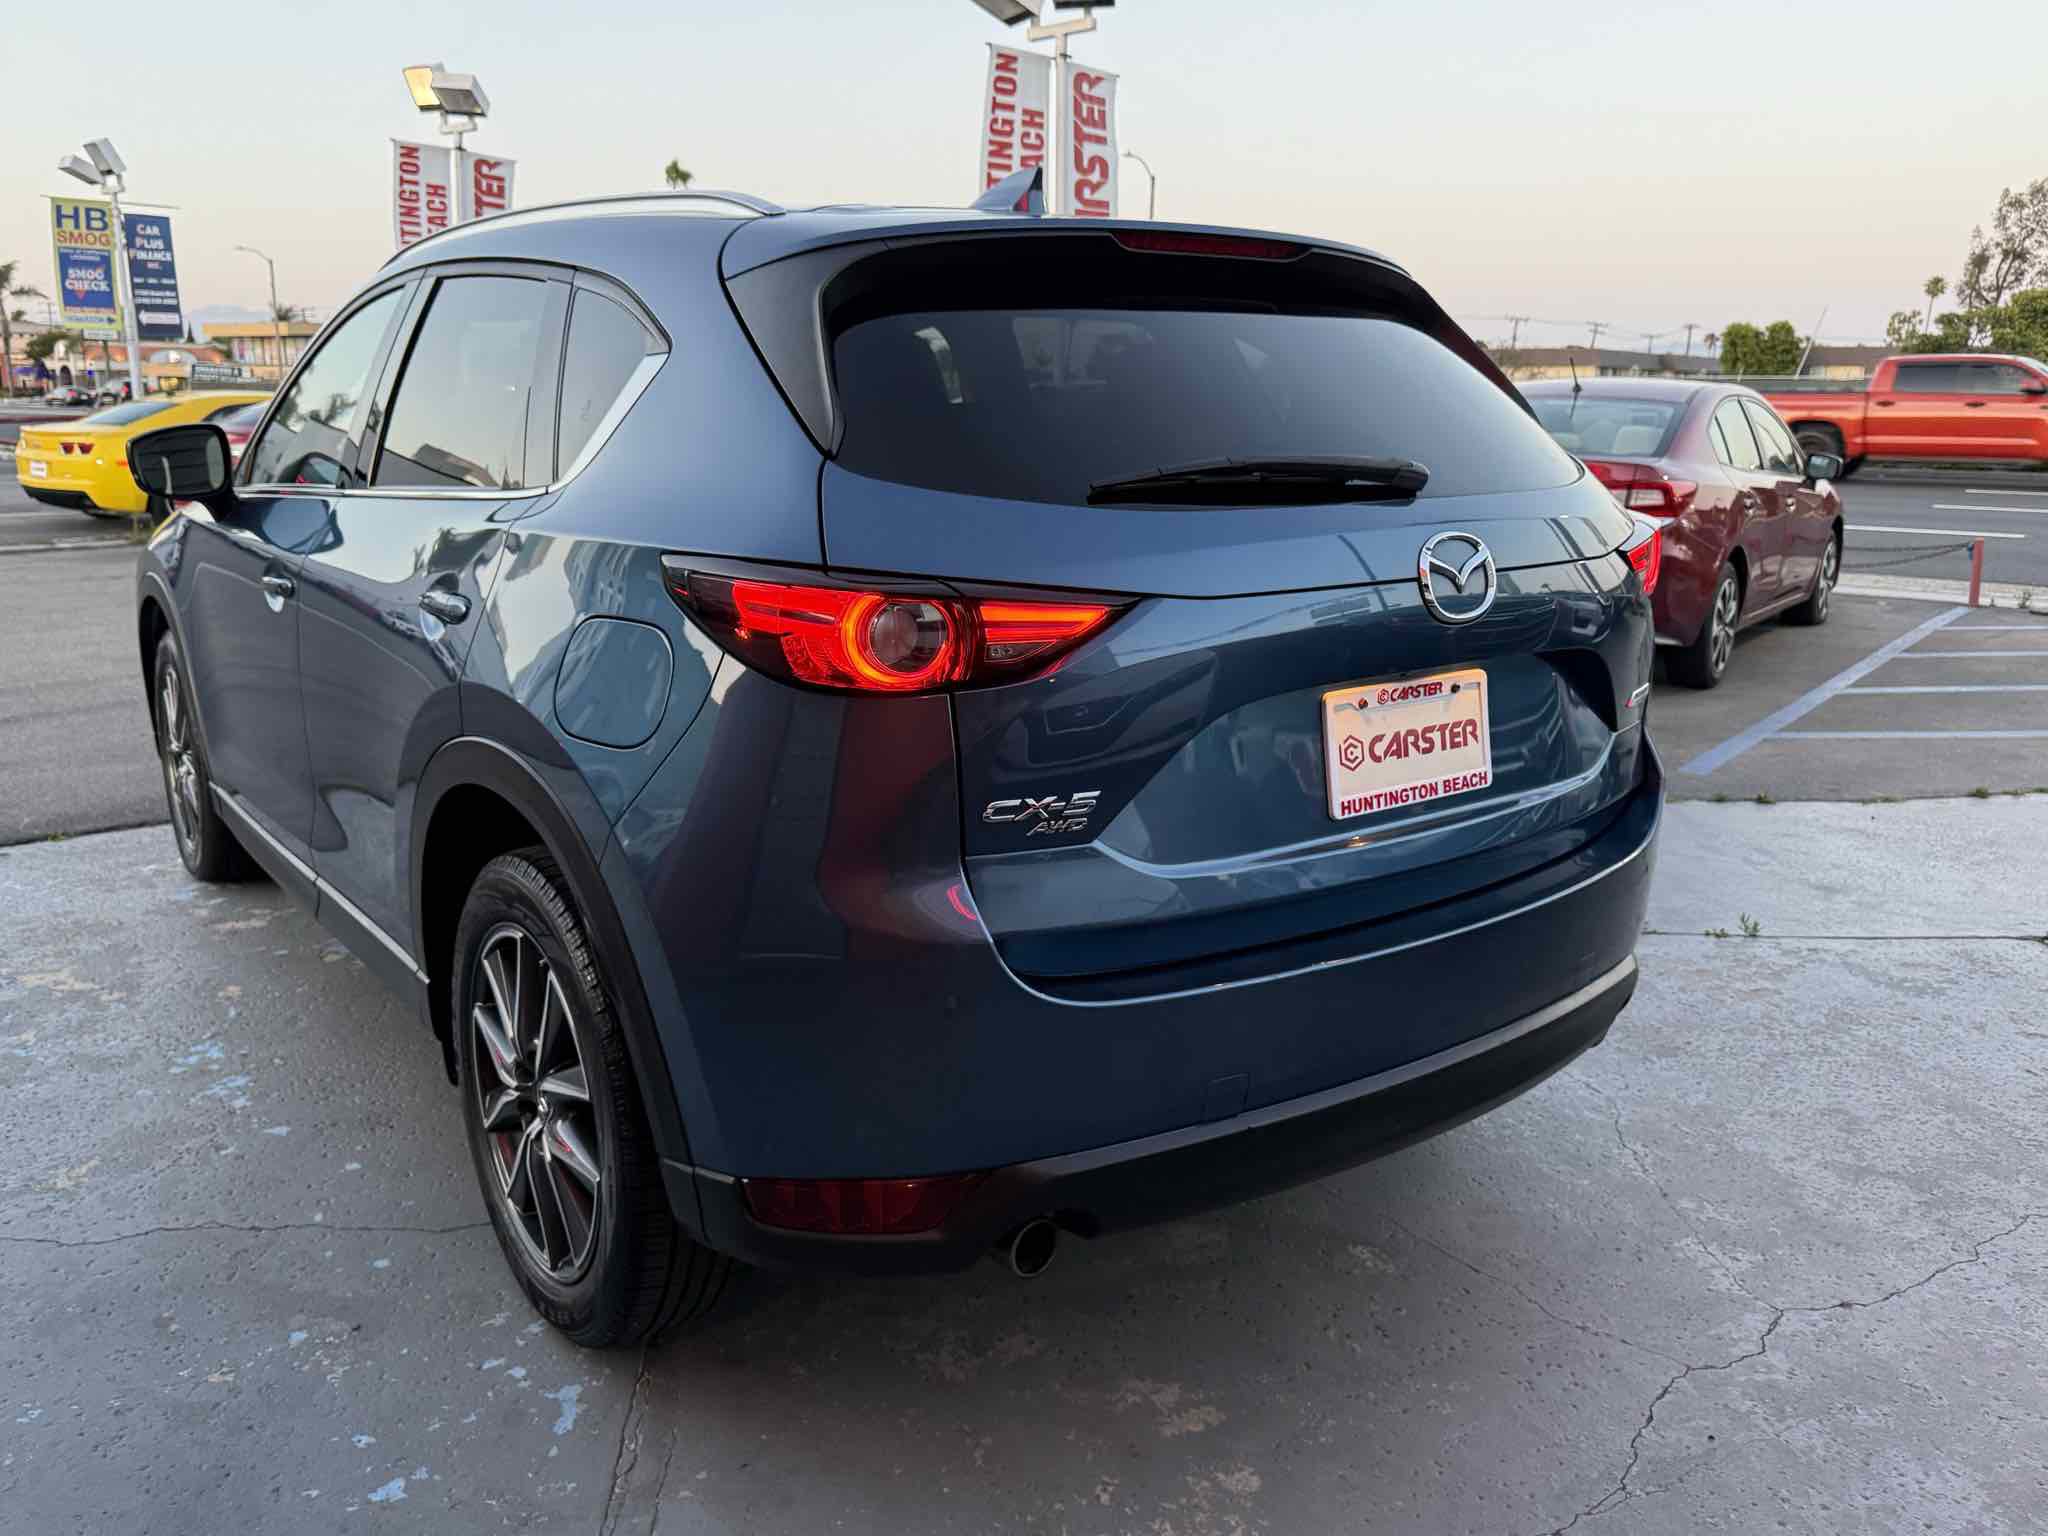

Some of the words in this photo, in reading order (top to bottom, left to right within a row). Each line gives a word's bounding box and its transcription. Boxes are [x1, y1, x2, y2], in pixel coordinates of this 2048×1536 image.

[399, 144, 422, 245] TINGTON
[56, 204, 109, 231] HB
[426, 183, 448, 234] ACH
[56, 230, 112, 247] SMOG
[136, 224, 160, 236] CAR
[135, 236, 164, 249] PLUS
[129, 248, 172, 261] FINANCE
[67, 268, 105, 281] SMOG
[65, 279, 111, 292] CHECK
[1391, 682, 1443, 701] CARSTER
[1369, 718, 1479, 764] CARSTER
[1341, 781, 1439, 817] HUNTINGTON
[1443, 771, 1488, 794] BEACH
[983, 790, 1101, 823] CX-5
[1026, 817, 1087, 836] AWD
